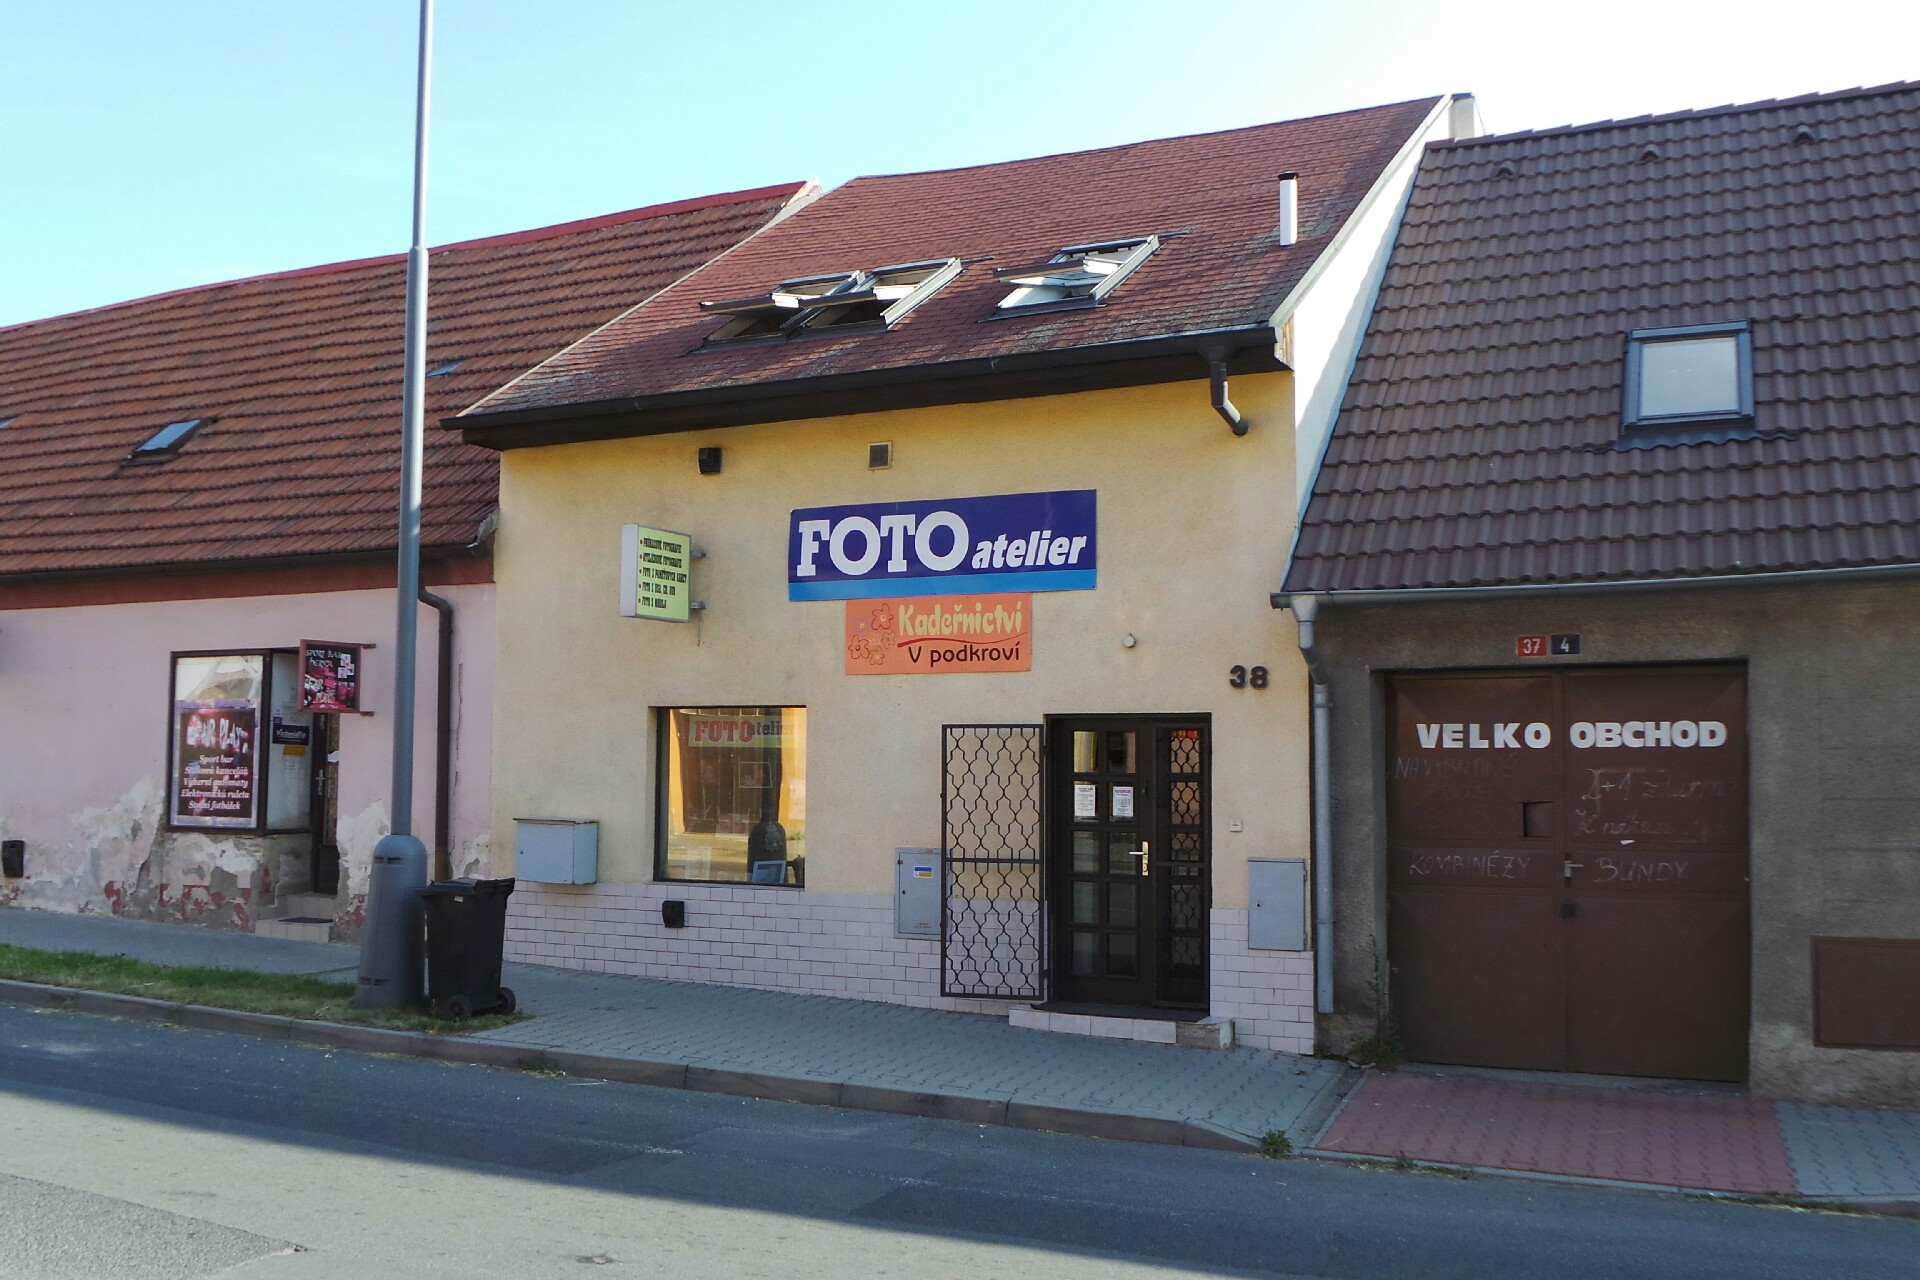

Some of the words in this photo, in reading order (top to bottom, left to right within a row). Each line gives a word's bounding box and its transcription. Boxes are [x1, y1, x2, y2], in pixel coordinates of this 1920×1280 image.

[796, 510, 970, 577] FOTO
[972, 529, 1087, 569] atelier
[899, 601, 1022, 636] Kadeřnictví
[929, 641, 1021, 668] podkroví
[1522, 638, 1541, 654] 37
[1560, 637, 1570, 653] 4
[1229, 664, 1269, 690] 38
[694, 720, 753, 742] FOTO
[1416, 722, 1550, 749] VELKO
[1569, 721, 1728, 748] OBCHOD
[1410, 850, 1531, 879] KOMBINÉZY
[1592, 857, 1690, 883] BUNDY
